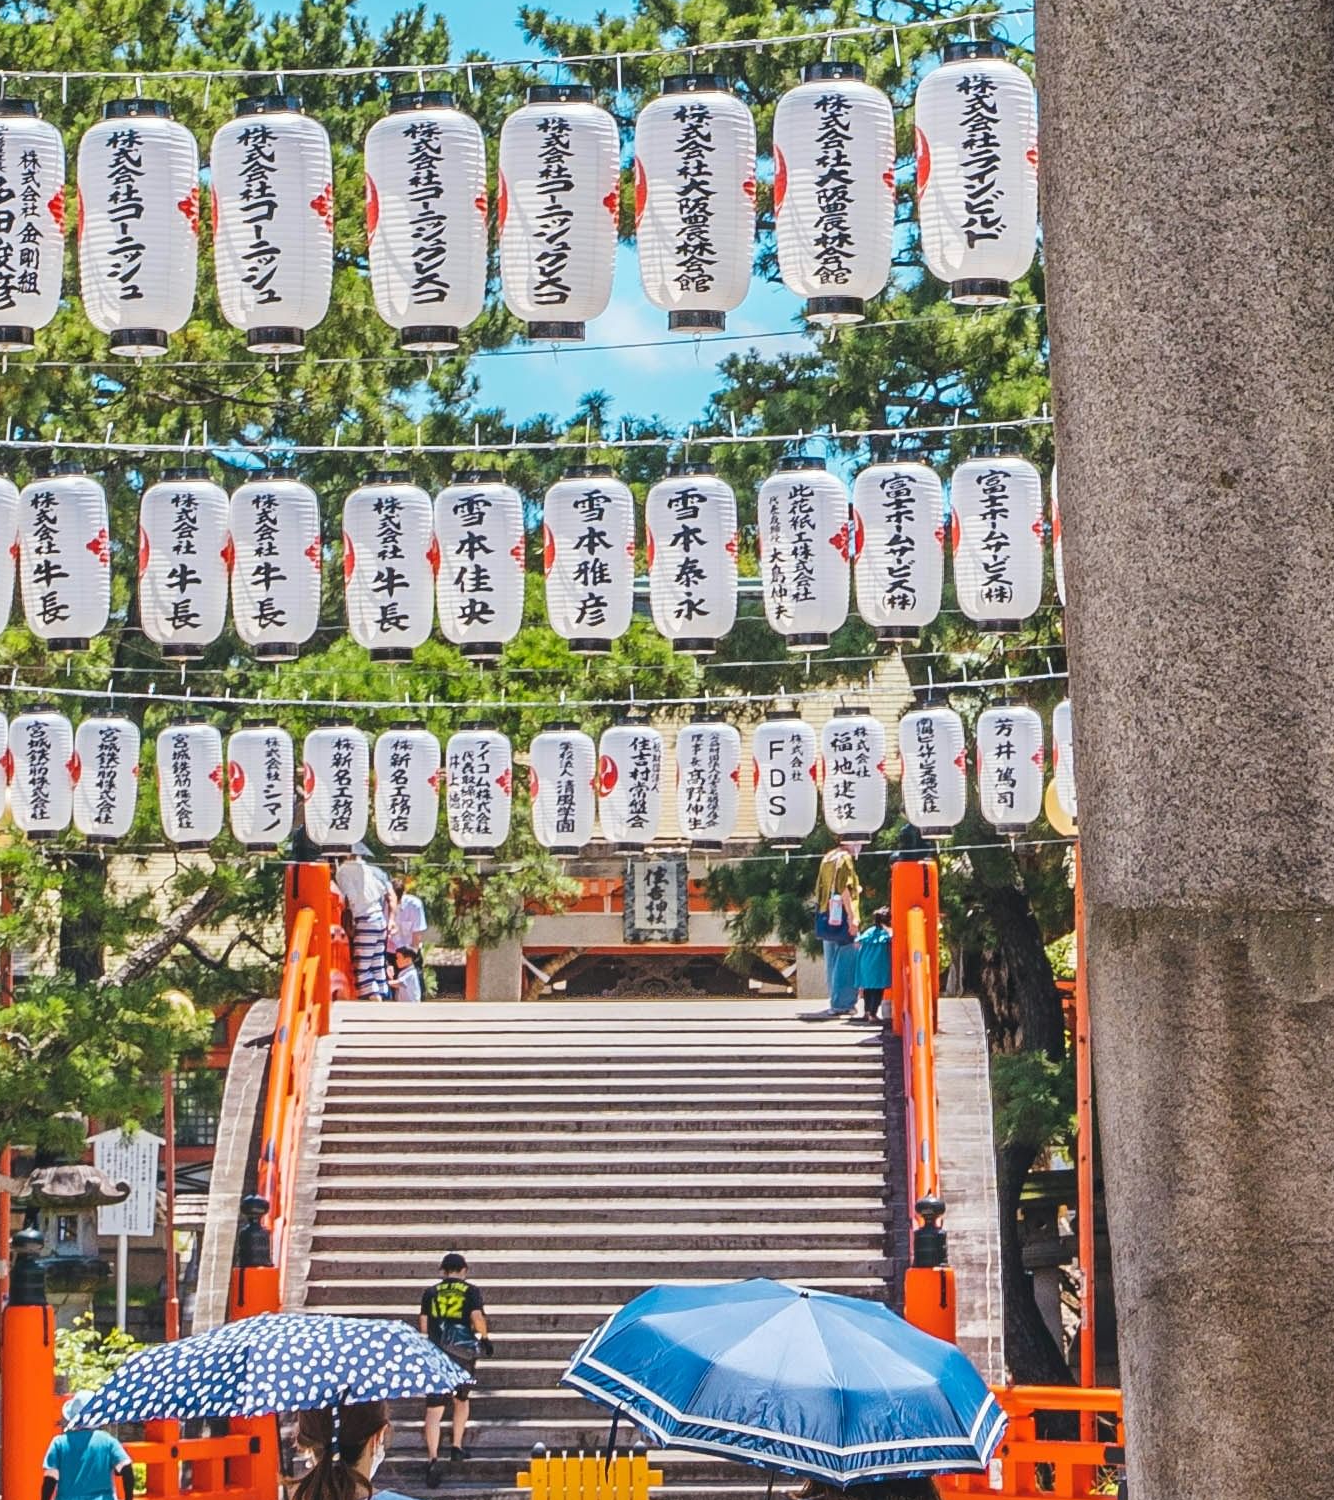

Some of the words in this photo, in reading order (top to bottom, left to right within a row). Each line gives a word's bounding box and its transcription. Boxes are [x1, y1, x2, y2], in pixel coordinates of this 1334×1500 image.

[105, 130, 146, 300] 株式会社コーニッシュ
[236, 124, 282, 304] 株式会社コーニッシュ
